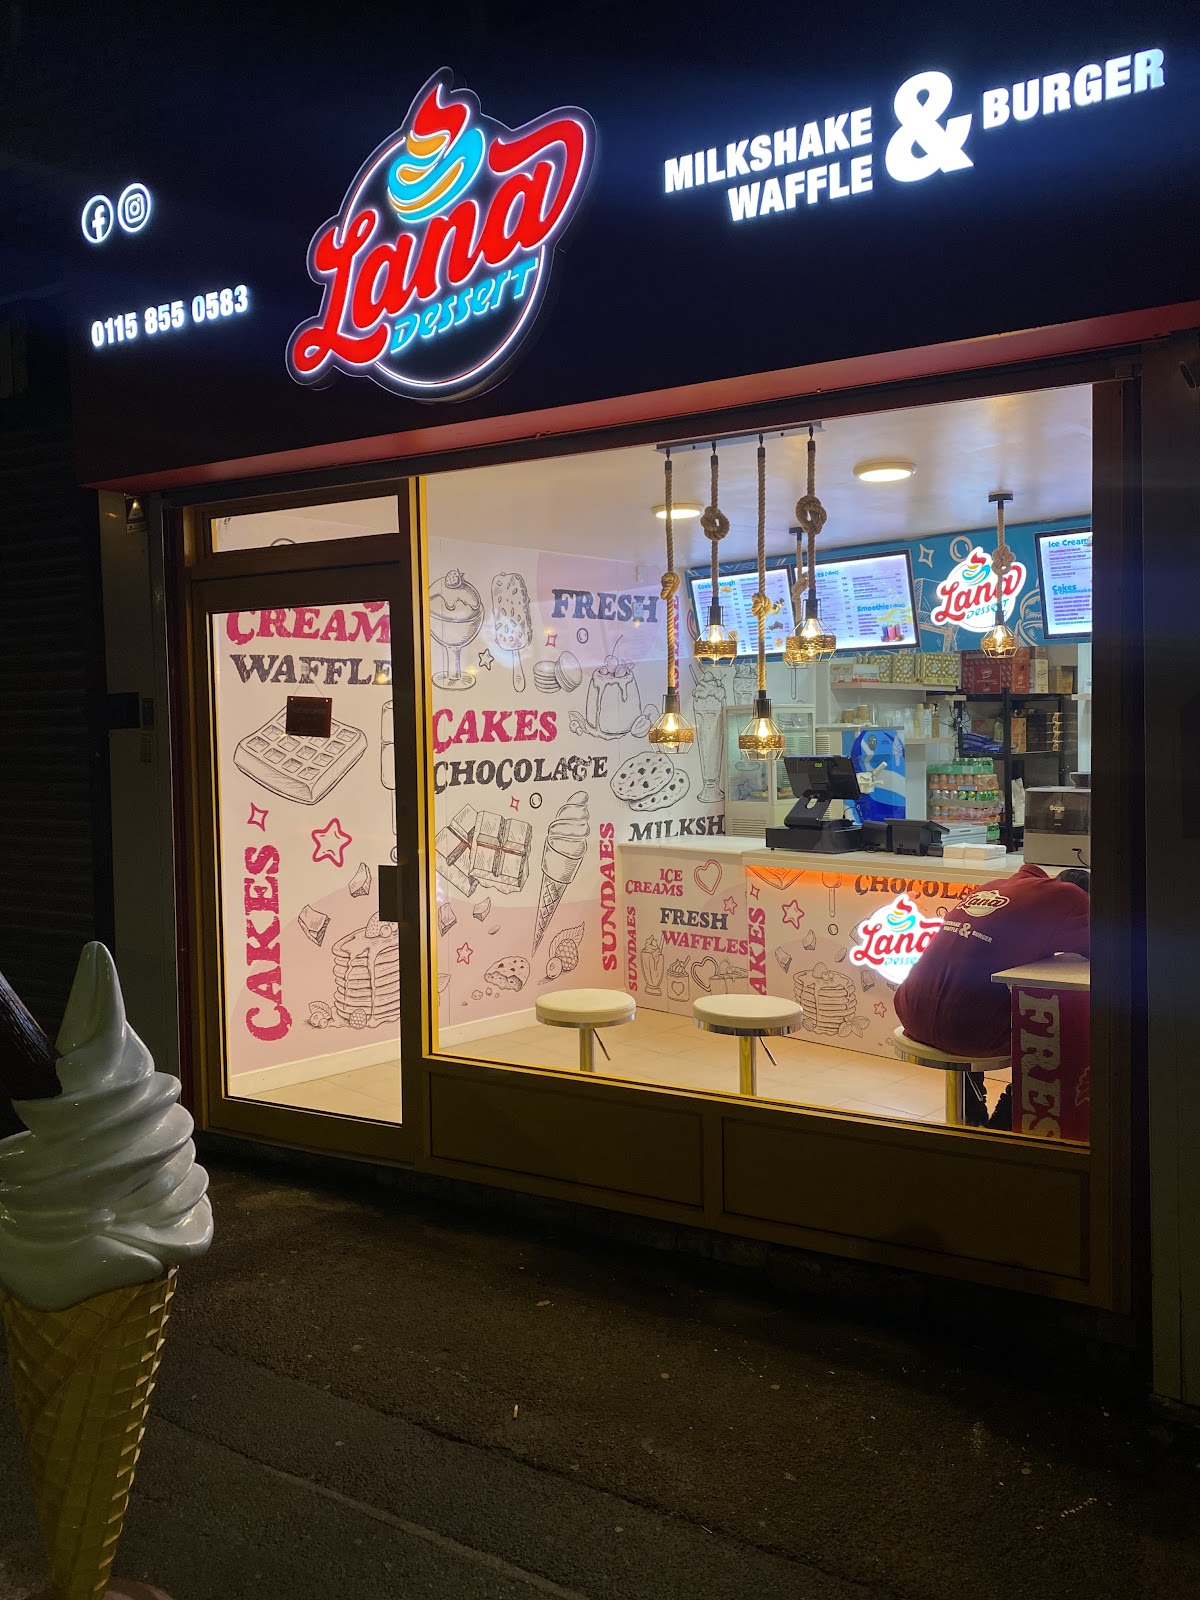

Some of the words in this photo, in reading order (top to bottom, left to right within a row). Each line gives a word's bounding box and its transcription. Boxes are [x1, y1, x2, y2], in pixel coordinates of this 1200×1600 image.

[885, 70, 976, 183] &
[981, 47, 1165, 130] BURGER
[664, 107, 874, 193] MILKSHAKE
[727, 154, 874, 222] WAFFLE
[292, 118, 588, 374] Lana
[91, 311, 138, 347] 0115
[144, 299, 185, 335] 855
[192, 284, 248, 323] 0583
[551, 588, 660, 623] FRESH
[857, 602, 889, 612] Smoothie
[432, 708, 558, 754] CAKES
[600, 821, 618, 972] SUNDAES
[625, 879, 684, 897] CREAMS
[659, 868, 684, 885] ICE
[244, 844, 293, 1042] CAKES
[627, 906, 638, 992] SUNDAES
[660, 907, 729, 931] FRESH
[661, 929, 749, 956] WAFFLES
